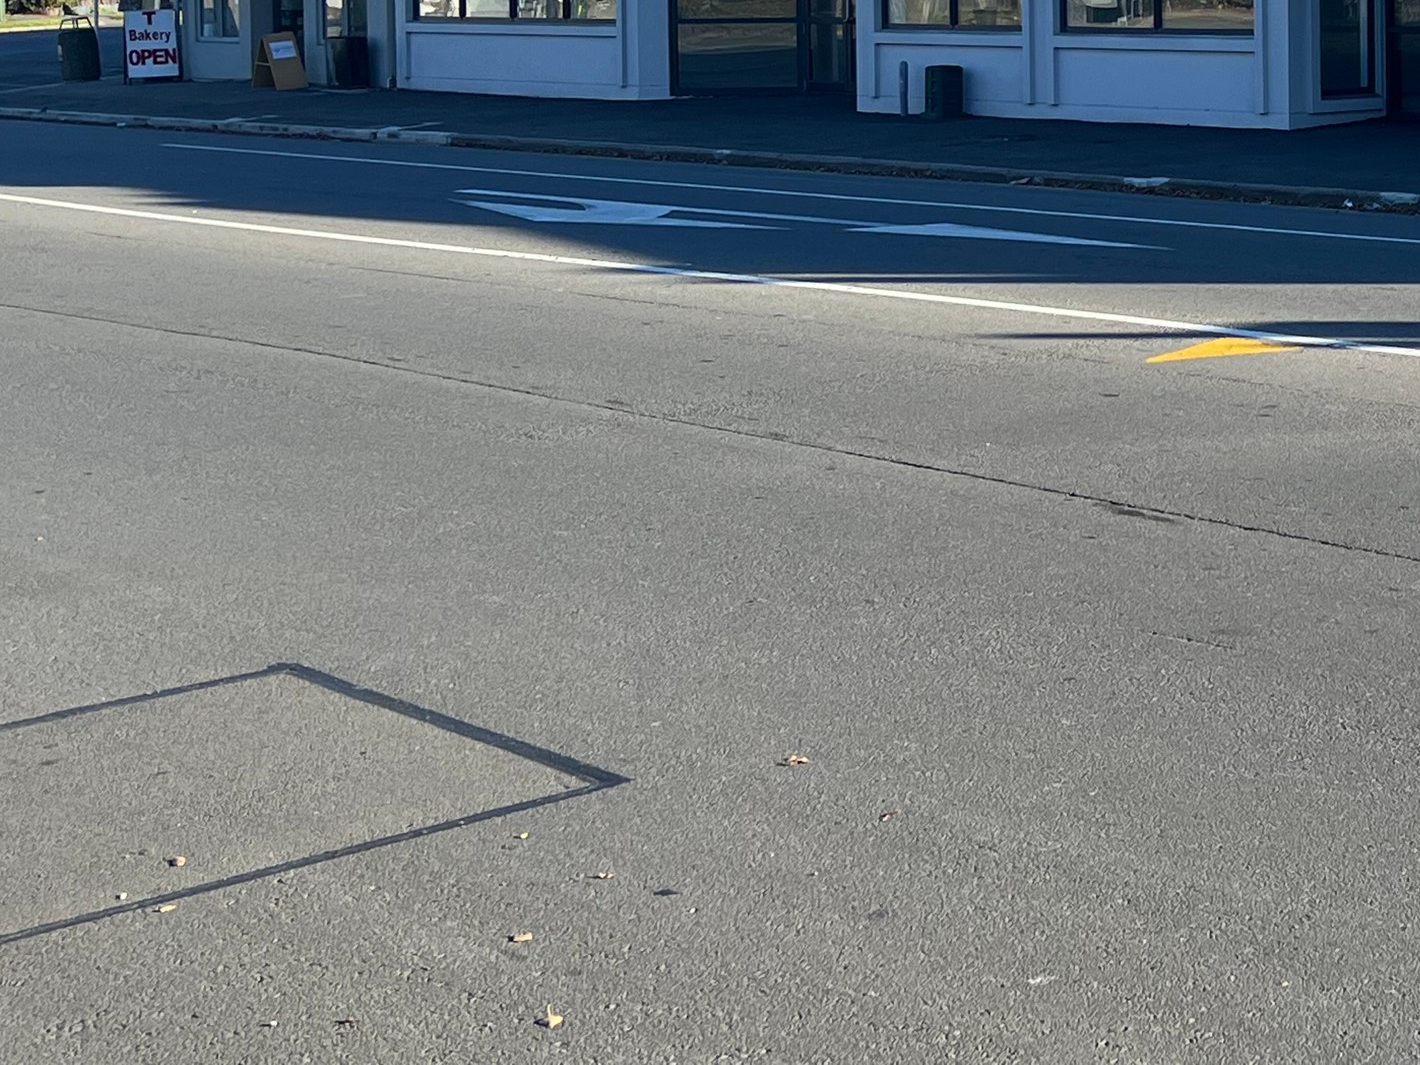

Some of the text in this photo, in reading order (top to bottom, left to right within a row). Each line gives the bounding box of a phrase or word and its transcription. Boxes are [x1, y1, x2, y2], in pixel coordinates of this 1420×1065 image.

[142, 11, 156, 25] T
[129, 29, 171, 43] Bakery
[129, 48, 177, 66] OPEN
